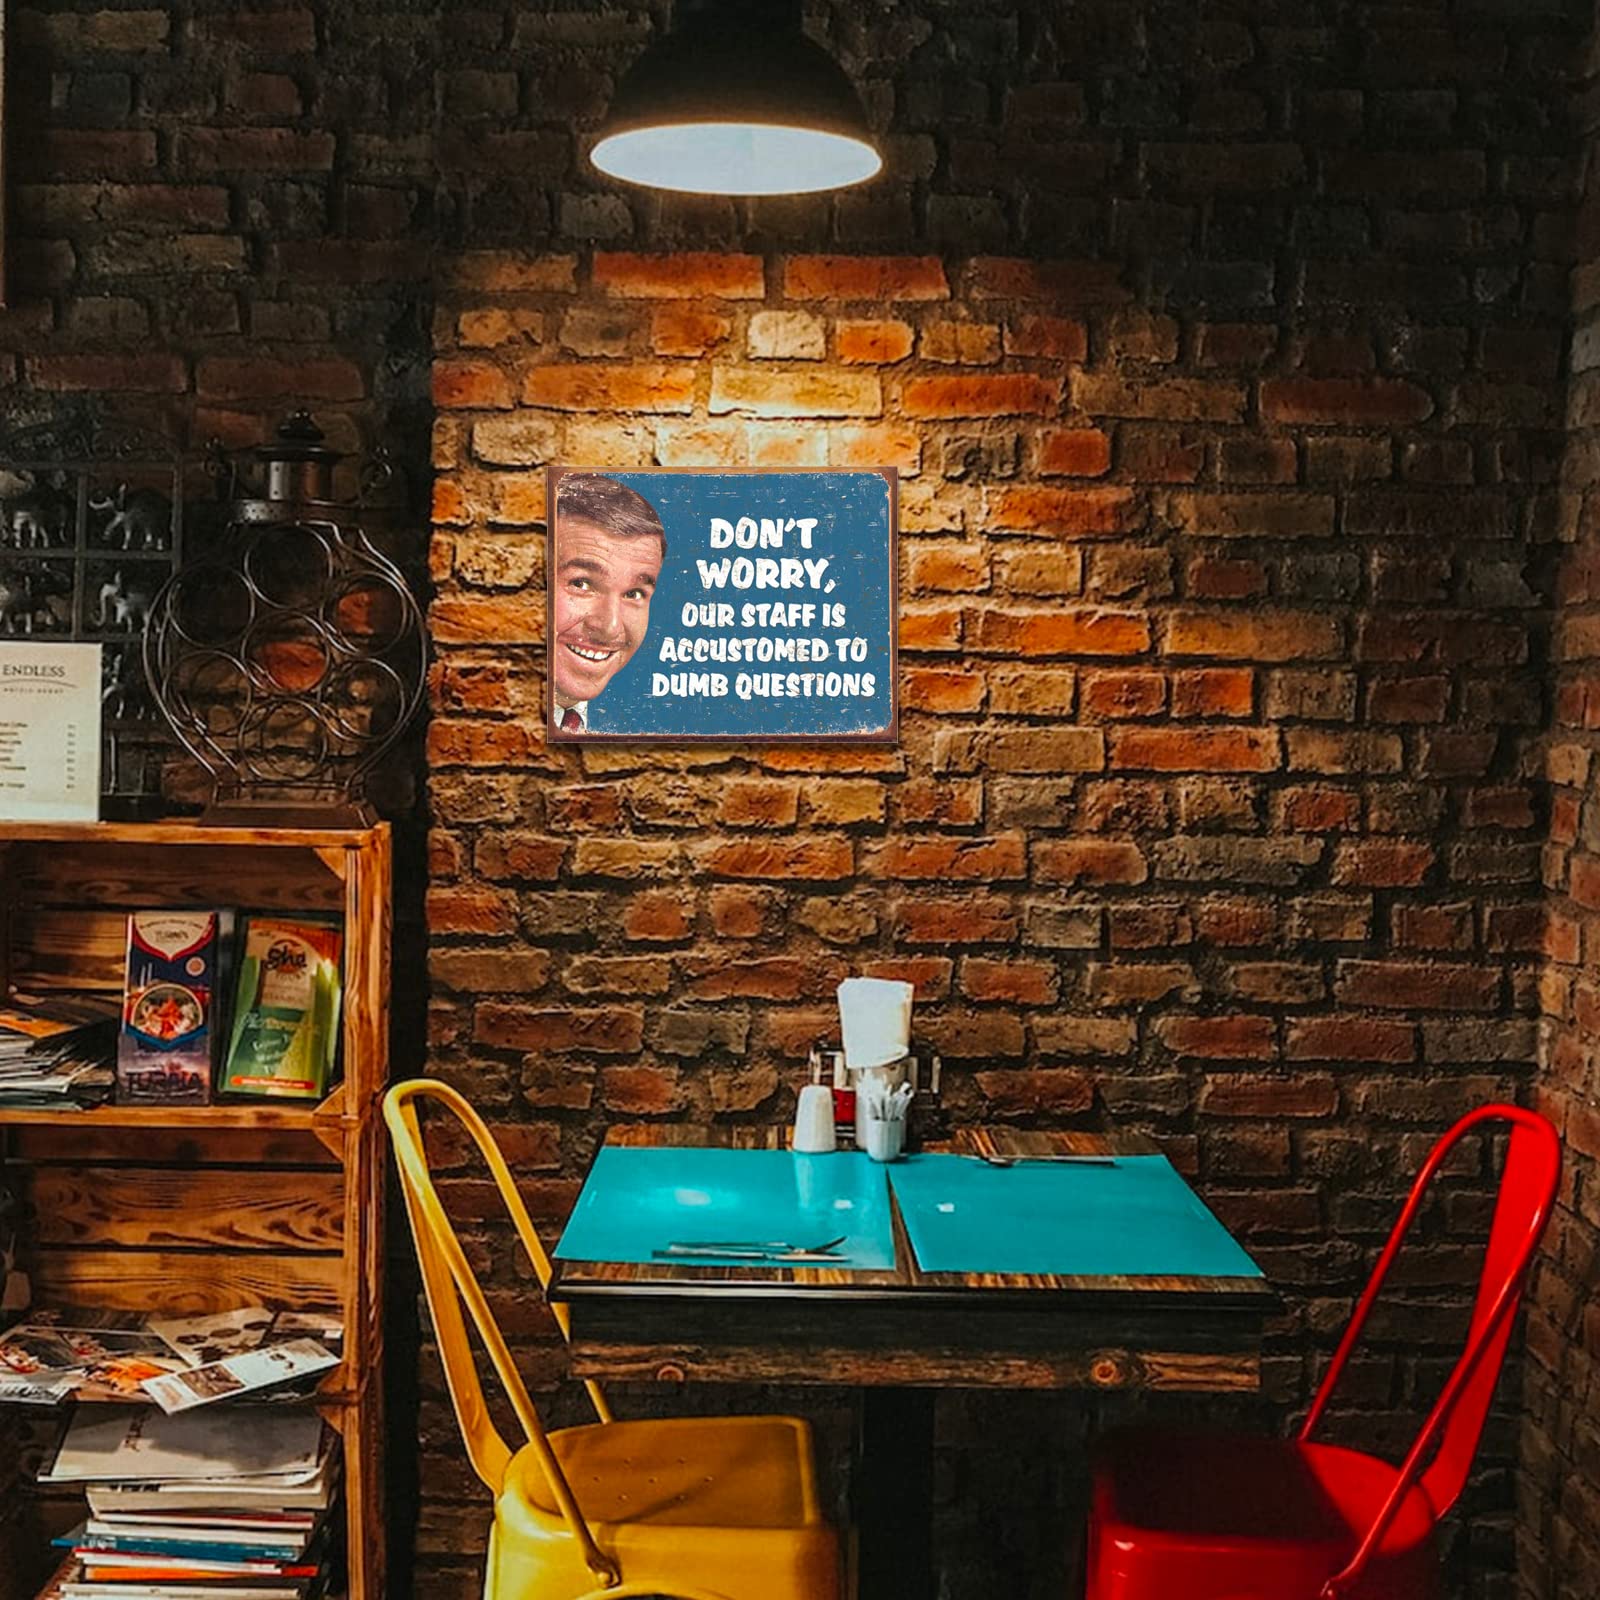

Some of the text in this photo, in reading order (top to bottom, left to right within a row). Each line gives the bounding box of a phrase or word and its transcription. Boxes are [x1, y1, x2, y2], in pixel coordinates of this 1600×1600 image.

[711, 517, 818, 549] DON'T
[697, 558, 836, 593] WORRY,
[682, 603, 846, 627] OUR STAFF IS
[660, 637, 868, 662] ACCUSTOMED TO
[4, 664, 66, 677] ENDLESS
[653, 673, 876, 700] DUMB QUESTIONS
